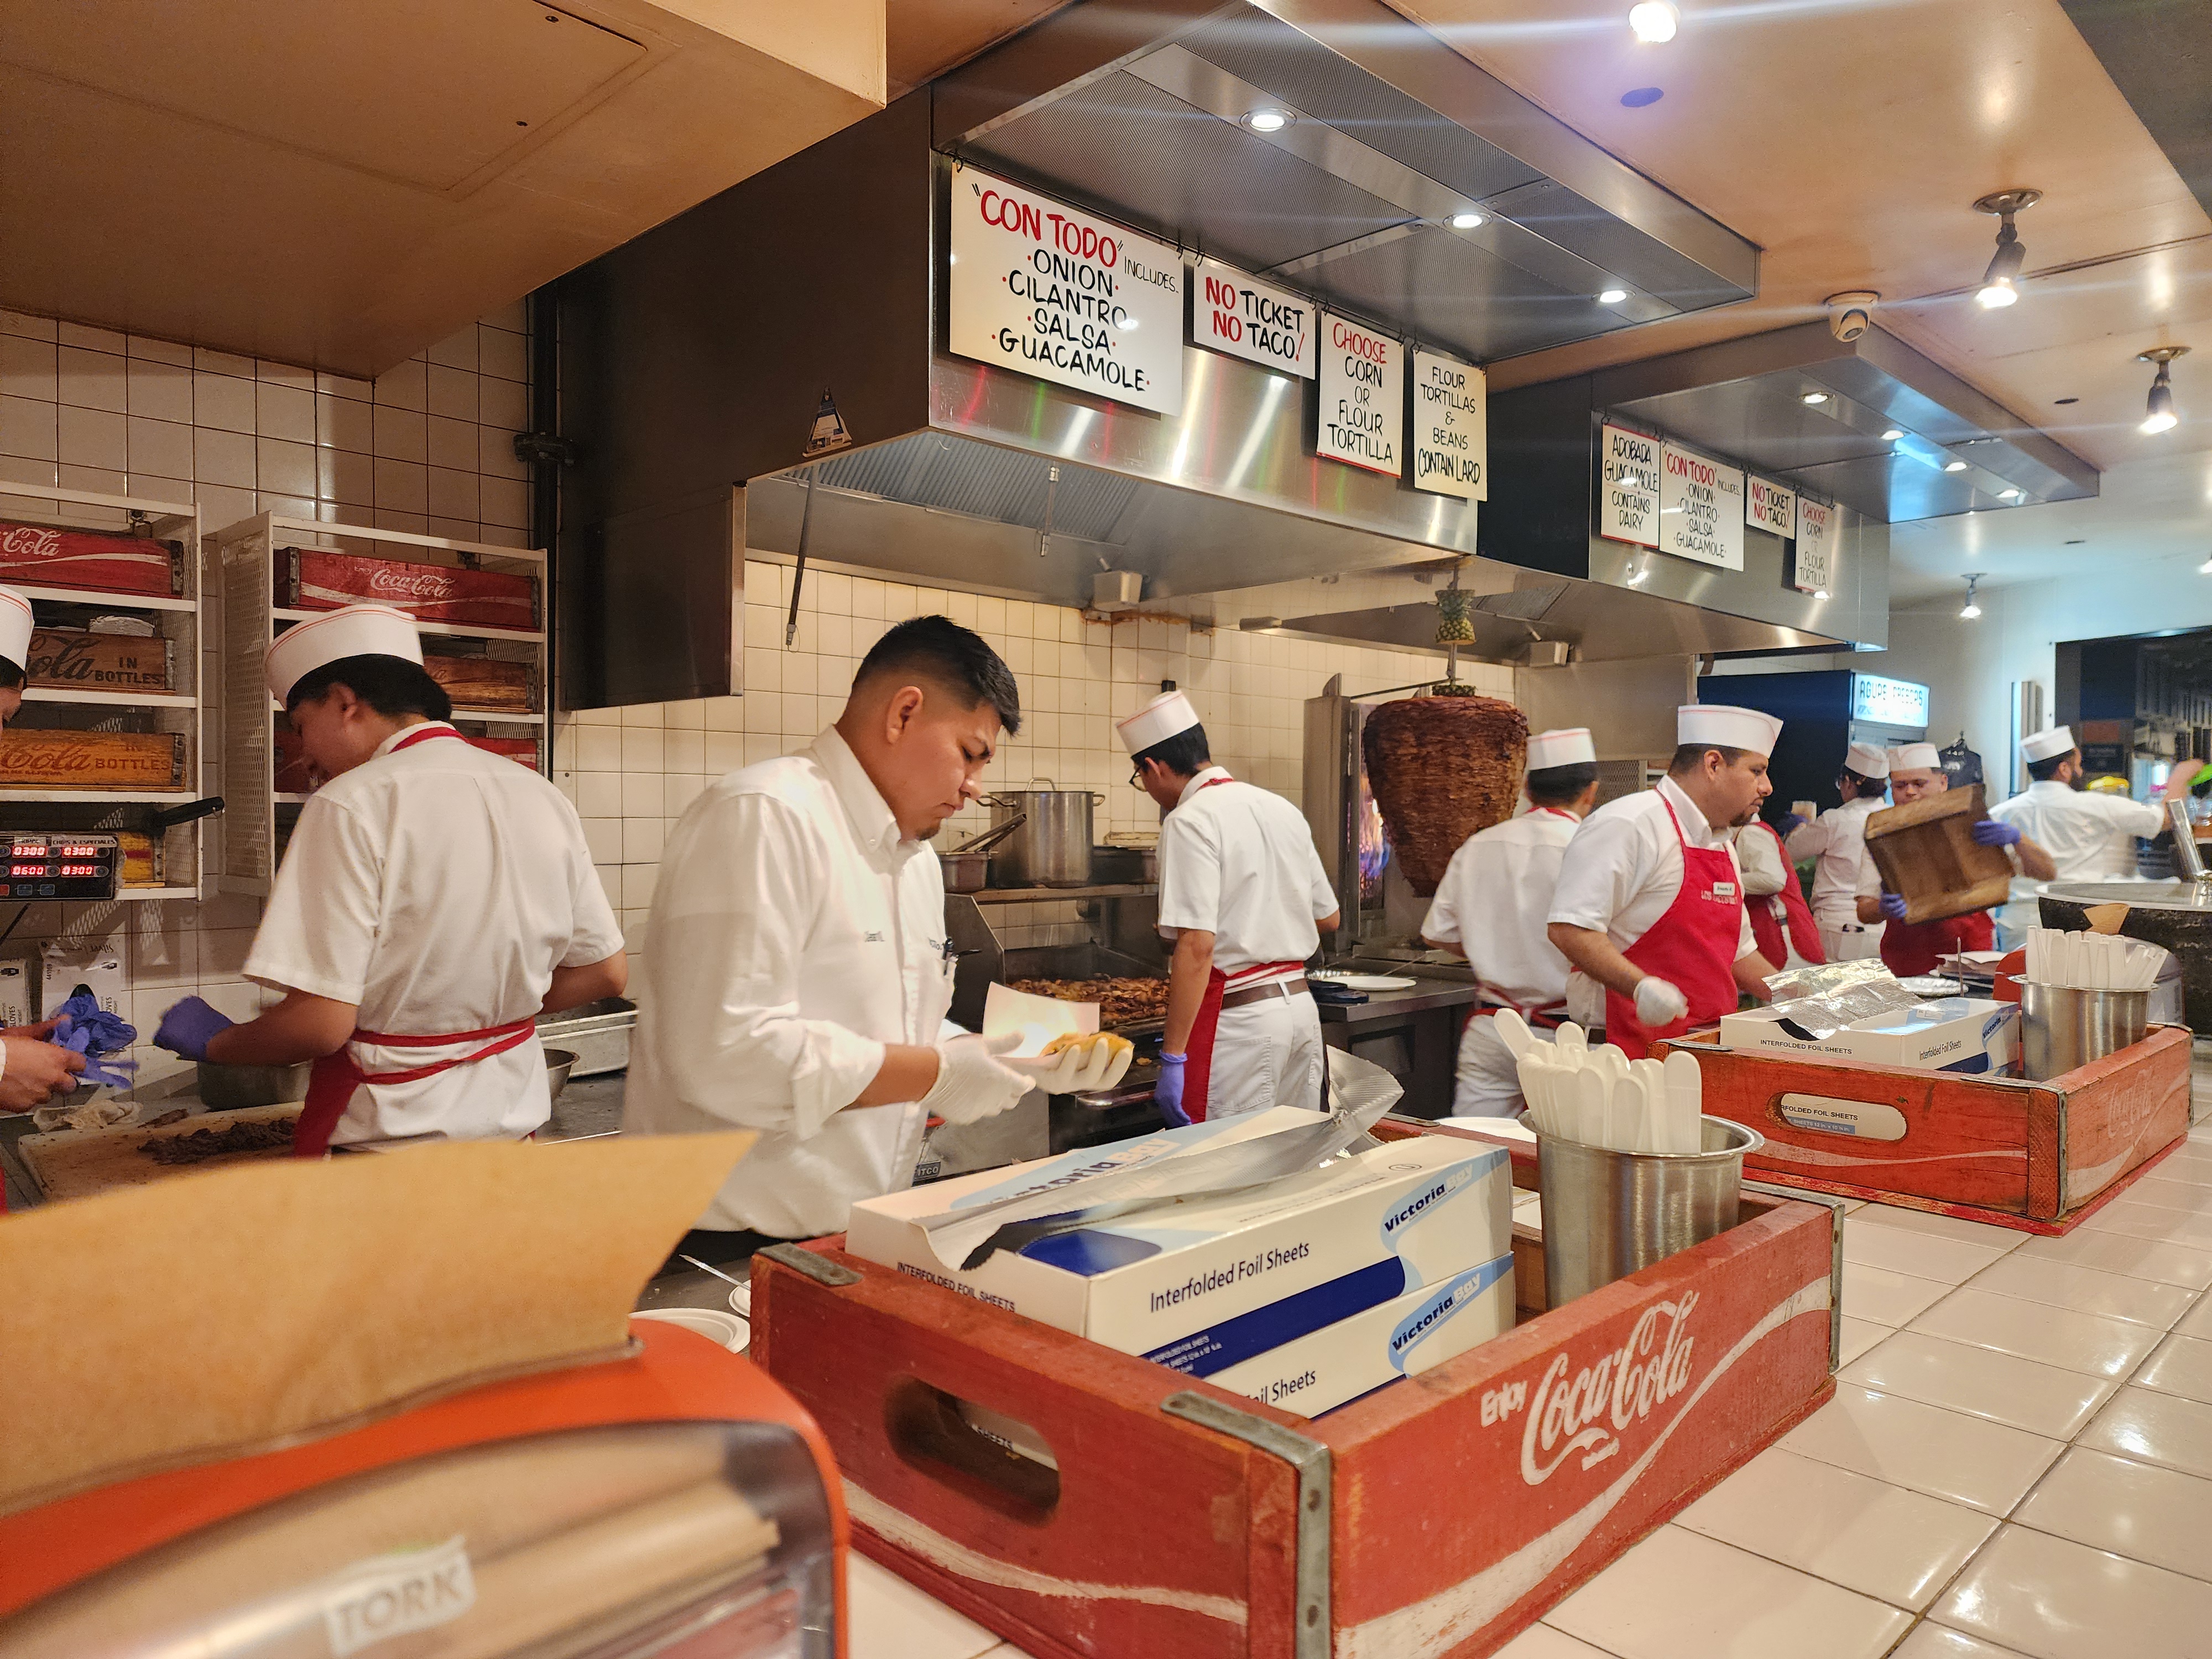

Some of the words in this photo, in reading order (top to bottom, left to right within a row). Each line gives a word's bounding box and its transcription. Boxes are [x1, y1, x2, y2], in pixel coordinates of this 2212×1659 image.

[1034, 249, 1113, 297] ONION
[1009, 270, 1128, 330] CILANTRO
[1206, 276, 1235, 310] NO
[1240, 290, 1304, 333] TICKET
[1034, 308, 1111, 356] SALSA
[1213, 310, 1241, 342] NO
[1246, 323, 1305, 362] TACO!
[1333, 322, 1387, 363] CHOOSE
[1000, 328, 1145, 392] GUACAMOLE
[1345, 356, 1382, 388] CORN
[1432, 367, 1465, 390] FLOUR
[1355, 386, 1370, 406] OR
[1421, 383, 1475, 414] TORTILLAS
[1339, 399, 1383, 436] FLOUR
[1445, 411, 1455, 425] &
[1327, 424, 1393, 465] TORTILLA
[1433, 427, 1468, 450] BEANS
[1613, 435, 1652, 466] ADOBADA
[1418, 448, 1453, 477] CONTAIN
[1457, 456, 1480, 485] LARD
[1605, 460, 1658, 492] GUACAMOLE
[1612, 491, 1650, 514] CONTAINS
[1688, 483, 1713, 504] ONION
[1752, 483, 1765, 502] NO
[1766, 488, 1790, 510] TICKET
[1619, 510, 1644, 531] DAIRY
[1754, 502, 1766, 521] NO
[1767, 508, 1790, 529] TACO!
[1803, 502, 1825, 524] CHOOSE
[1689, 519, 1713, 538] SALSA
[1807, 522, 1823, 539] CORN
[1677, 532, 1725, 557] GUACAMOLE
[1805, 551, 1824, 571] FLOUR
[1799, 567, 1827, 587] TORTILLA
[119, 657, 137, 669] IN
[95, 670, 162, 684] BOTTLES
[95, 758, 171, 770] BOTTLES
[1760, 1040, 1806, 1049] INTERFOLDED
[1825, 1046, 1852, 1055] SHEETS
[1919, 1044, 1942, 1061] Interfolded
[1949, 1040, 1961, 1051] Sheets
[1781, 1105, 1812, 1114] RFOLDED
[1831, 1112, 1858, 1121] SHEETS
[917, 1166, 939, 1176] ITCO
[1384, 1184, 1446, 1232] Victoria
[1446, 1164, 1473, 1188] Bay
[898, 1261, 955, 1290] INTERFOLDED
[957, 1283, 977, 1299] FOIL
[980, 1291, 1015, 1313] SHEETS
[1151, 1263, 1234, 1313] Interfolded
[1239, 1253, 1263, 1280] Foil
[1266, 1242, 1310, 1270] Sheets
[1392, 1296, 1453, 1350] Victoria
[1453, 1272, 1480, 1301] Bay
[1272, 1370, 1316, 1402] Sheets
[1480, 1381, 1528, 1428] Enjoy
[1521, 1290, 1700, 1486] Coca-Cola
[337, 1565, 461, 1639] TORK
